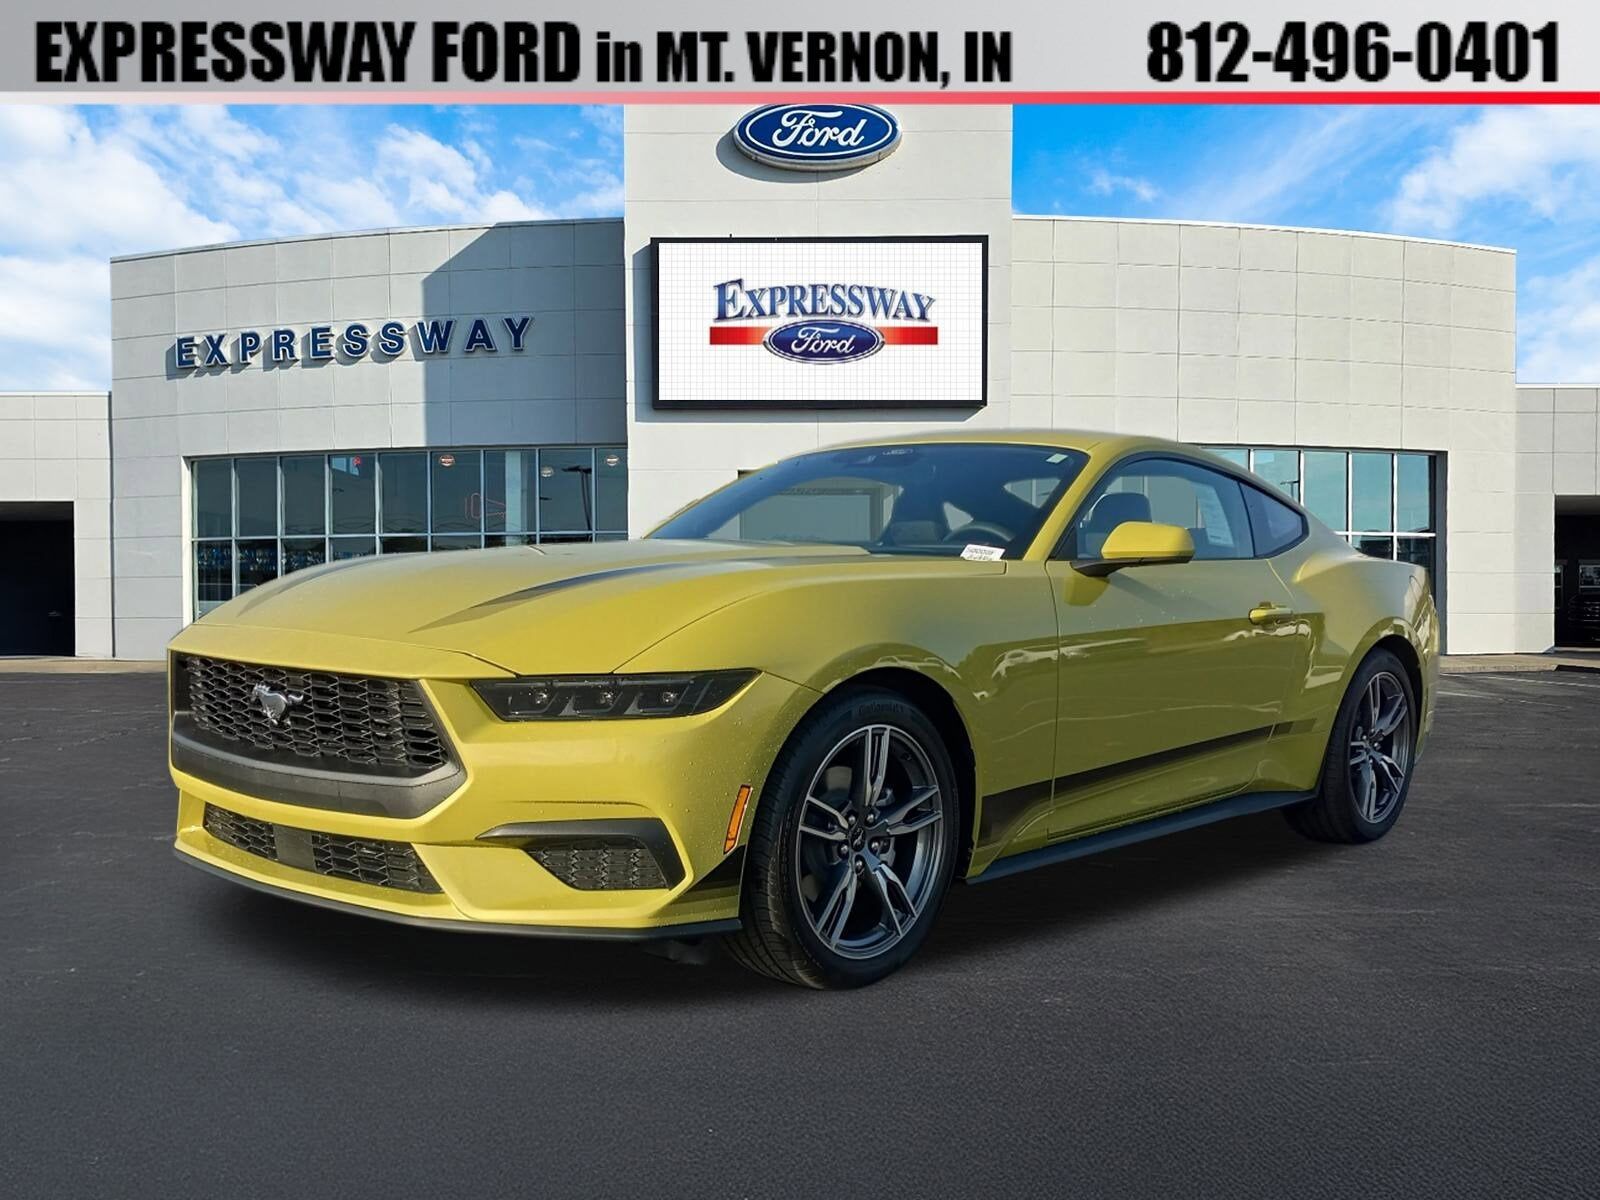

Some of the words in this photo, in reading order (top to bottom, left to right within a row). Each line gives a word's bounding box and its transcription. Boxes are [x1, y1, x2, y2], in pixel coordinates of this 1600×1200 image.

[772, 110, 868, 148] Ford
[713, 278, 936, 322] EXPRESSWAY
[174, 316, 533, 369] EXPRESSWAY
[790, 326, 854, 354] Ford
